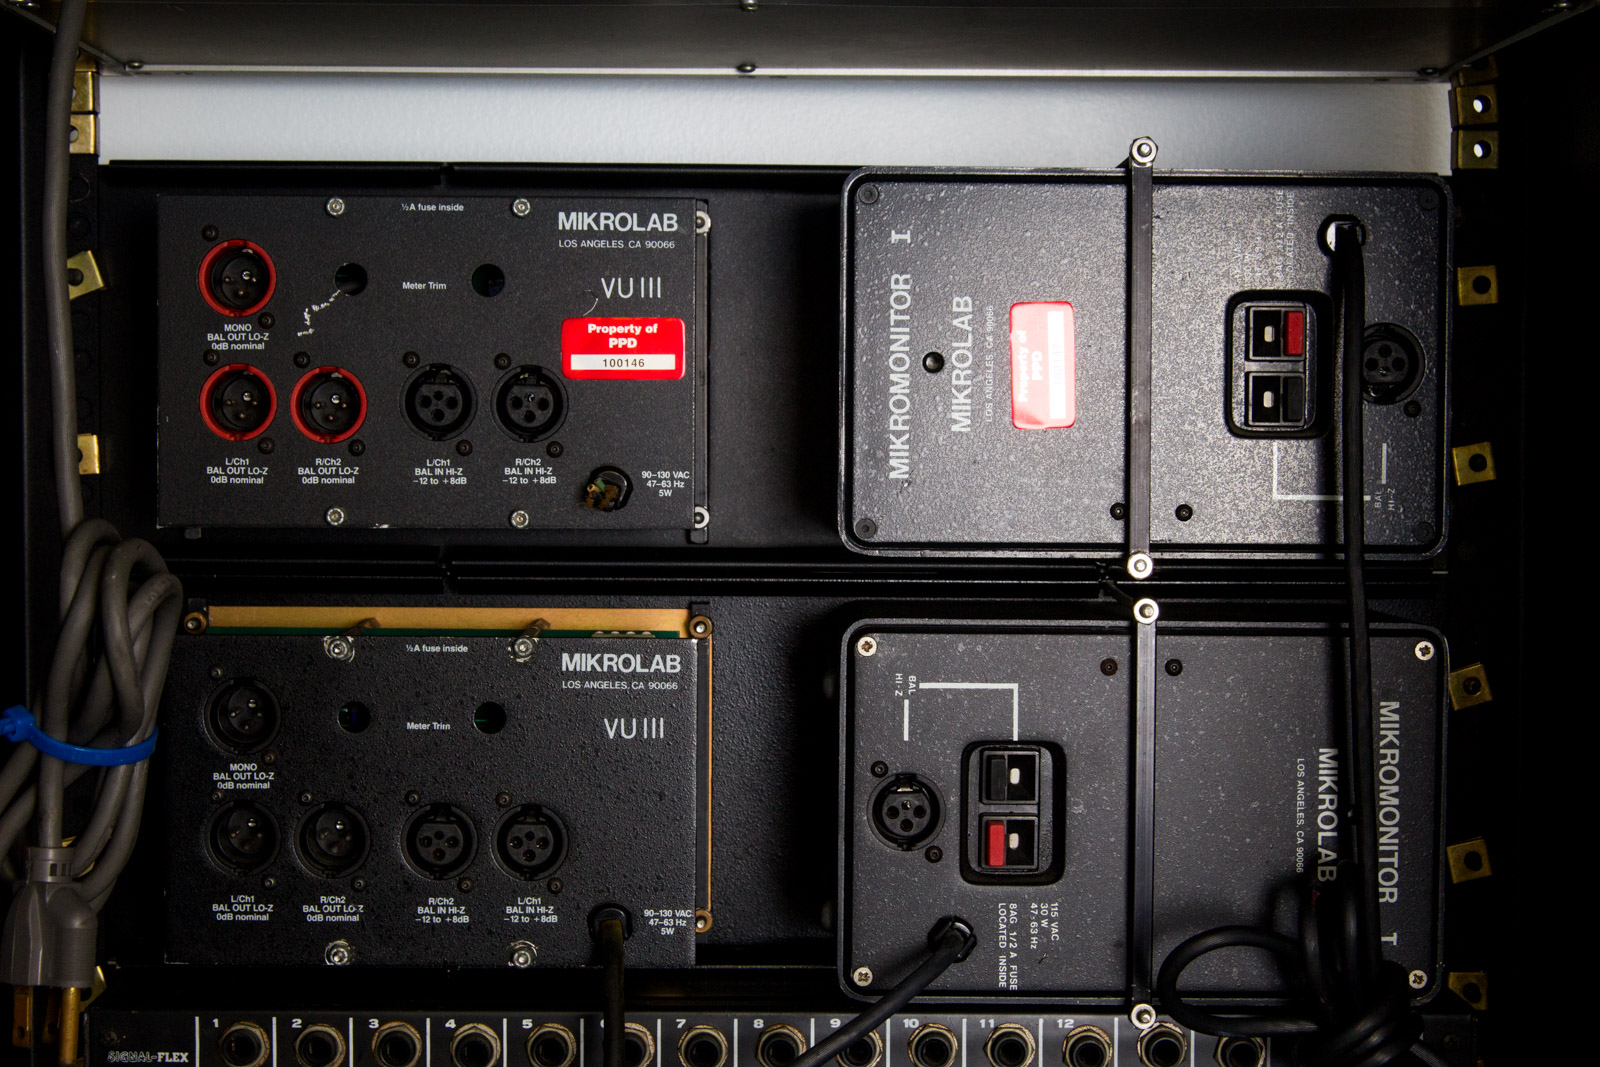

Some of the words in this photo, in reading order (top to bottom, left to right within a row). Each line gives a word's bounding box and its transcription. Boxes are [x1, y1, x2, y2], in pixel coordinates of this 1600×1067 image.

[418, 202, 436, 212] fuse
[438, 204, 464, 212] inside
[558, 212, 678, 232] MIKROLAB
[890, 230, 911, 244] I
[558, 240, 578, 248] LOS
[628, 240, 642, 248] CA
[644, 240, 676, 248] 90066
[402, 282, 430, 290] Meter
[430, 282, 446, 290] Trim
[224, 324, 252, 332] MONO
[587, 323, 641, 334] Property
[645, 323, 658, 333] of
[208, 334, 230, 342] BAL
[228, 332, 246, 340] OUT
[248, 332, 270, 340] LO-Z
[986, 335, 994, 348] CA
[1016, 330, 1027, 343] of
[212, 342, 228, 350] 0dB
[609, 338, 637, 348] PPD
[602, 358, 645, 368] 100146
[951, 296, 972, 432] MIKROLAB
[1032, 351, 1042, 380] PPD
[889, 274, 911, 478] MIKROMONITOR
[1018, 346, 1029, 402] Property
[986, 404, 994, 422] LOS
[226, 458, 250, 466] L/Ch1
[316, 458, 342, 466] R/Ch2
[426, 458, 450, 466] L/Ch1
[516, 458, 542, 466] R/Ch2
[206, 466, 224, 474] BAL
[226, 466, 246, 474] OUT
[248, 466, 268, 476] LO-Z
[298, 466, 316, 476] BAL
[318, 466, 336, 474] OUT
[338, 466, 360, 474] LO-Z
[414, 468, 434, 476] BAL
[434, 468, 444, 476] IN
[446, 468, 464, 476] HI-Z
[504, 468, 522, 476] BAL
[536, 466, 554, 474] HI-Z
[672, 470, 690, 478] VAC
[210, 476, 228, 484] 0dB
[302, 476, 320, 484] 0dB
[520, 476, 528, 484] to
[674, 480, 684, 488] Hz
[658, 488, 672, 496] 5W
[422, 644, 440, 652] fuse
[442, 644, 468, 652] inside
[562, 653, 682, 673] MIKROLAB
[562, 680, 582, 688] LOS
[632, 682, 644, 690] CA
[648, 682, 678, 690] 90066
[895, 673, 903, 696] HI-Z
[908, 676, 916, 695] BAL
[406, 722, 430, 730] Meter
[432, 722, 450, 730] Trim
[230, 762, 258, 772] MONO
[1296, 758, 1305, 777] LOS
[212, 772, 232, 780] BAL
[232, 772, 252, 780] OUT
[252, 772, 274, 780] LO-Z
[218, 782, 234, 790] 0dB
[236, 782, 270, 790] nominal
[1378, 701, 1400, 903] MIKROMONITOR
[1318, 748, 1339, 882] MIKROLAB
[1296, 831, 1304, 844] CA
[1296, 846, 1304, 873] 90066
[230, 894, 254, 902] L/Ch1
[320, 896, 346, 904] R/Ch2
[428, 898, 454, 906] R/Ch2
[518, 896, 542, 904] L/Ch1
[212, 904, 230, 912] BAL
[232, 904, 252, 912] OUT
[252, 904, 274, 912] LO-Z
[302, 904, 322, 912] BAL
[322, 904, 342, 912] OUT
[344, 904, 364, 912] LO-Z
[418, 906, 436, 914] BAL
[438, 906, 446, 914] IN
[448, 906, 466, 914] HI-Z
[506, 906, 524, 914] BAL
[526, 906, 534, 914] IN
[536, 906, 556, 914] HI-Z
[1040, 903, 1048, 916] 30
[1050, 903, 1059, 918] 115
[216, 912, 234, 920] 0dB
[306, 914, 324, 922] 0dB
[674, 910, 694, 918] VAC
[432, 916, 442, 924] to
[676, 918, 686, 926] Hz
[1040, 918, 1048, 928] W
[998, 902, 1007, 949] LOCATED
[660, 928, 674, 936] 5W
[1050, 922, 1060, 941] VAC
[1009, 931, 1018, 949] 1/2
[1030, 936, 1038, 950] Hz
[998, 956, 1006, 988] INSIDE
[1010, 965, 1018, 991] FUSE
[212, 1018, 218, 1028] 1
[292, 1018, 302, 1028] 2
[368, 1018, 380, 1028] 3
[444, 1018, 456, 1028] 4
[522, 1018, 532, 1028] 5
[676, 1018, 686, 1028] 7
[754, 1018, 764, 1028] 8
[830, 1018, 842, 1028] 9
[902, 1018, 922, 1028] 10
[980, 1018, 994, 1028] 11
[1056, 1018, 1076, 1028] 12
[107, 1050, 190, 1064] SIGNAL-FLEX
